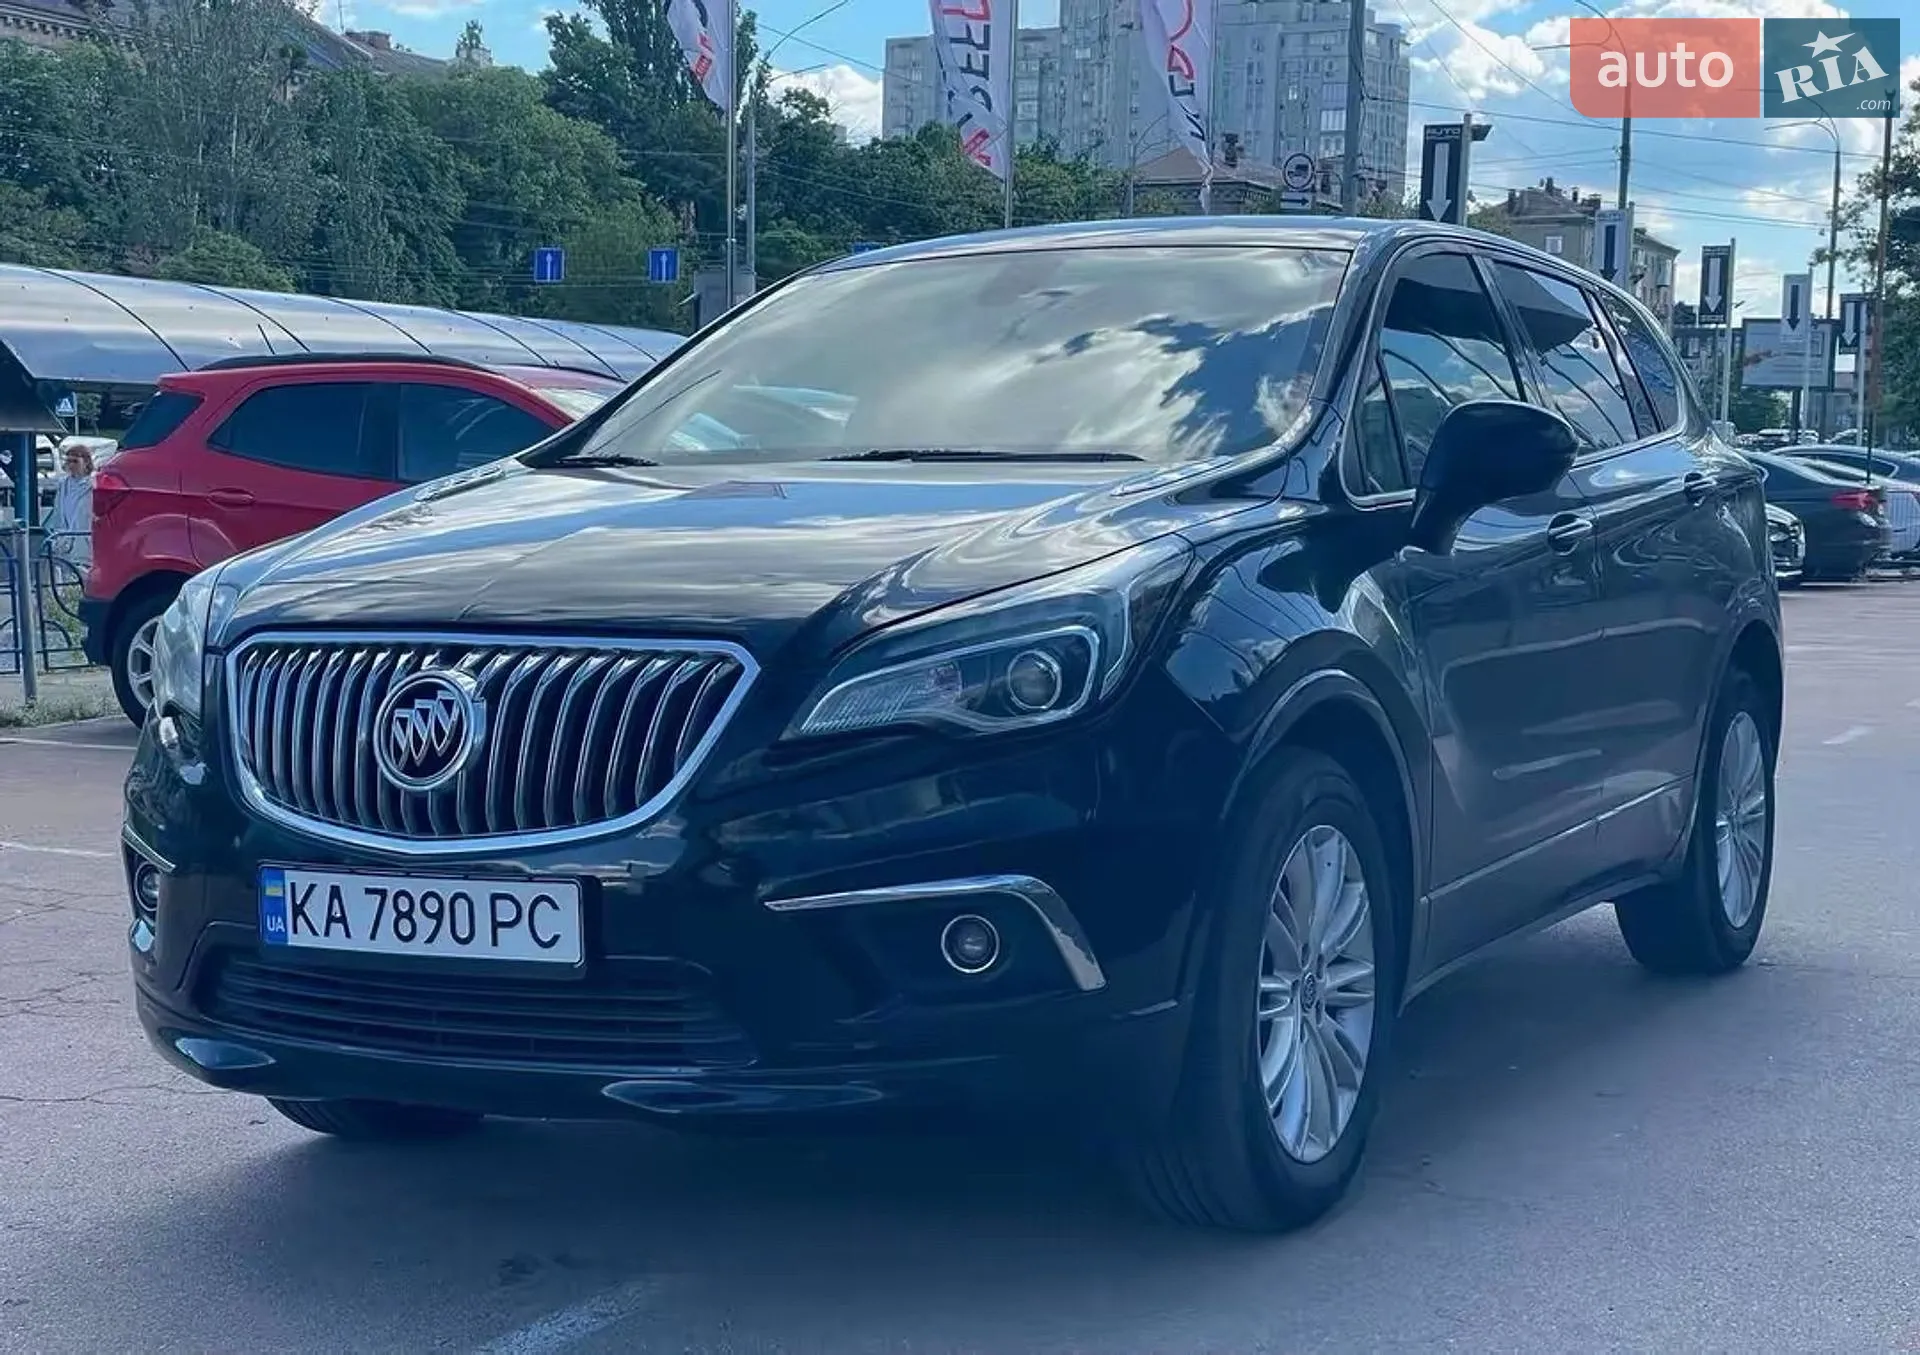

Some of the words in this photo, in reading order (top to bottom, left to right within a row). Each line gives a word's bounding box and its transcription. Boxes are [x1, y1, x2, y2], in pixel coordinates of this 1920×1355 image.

[266, 914, 285, 934] UA
[290, 882, 351, 939] KA
[364, 887, 476, 946] 7890
[489, 892, 561, 949] PC
